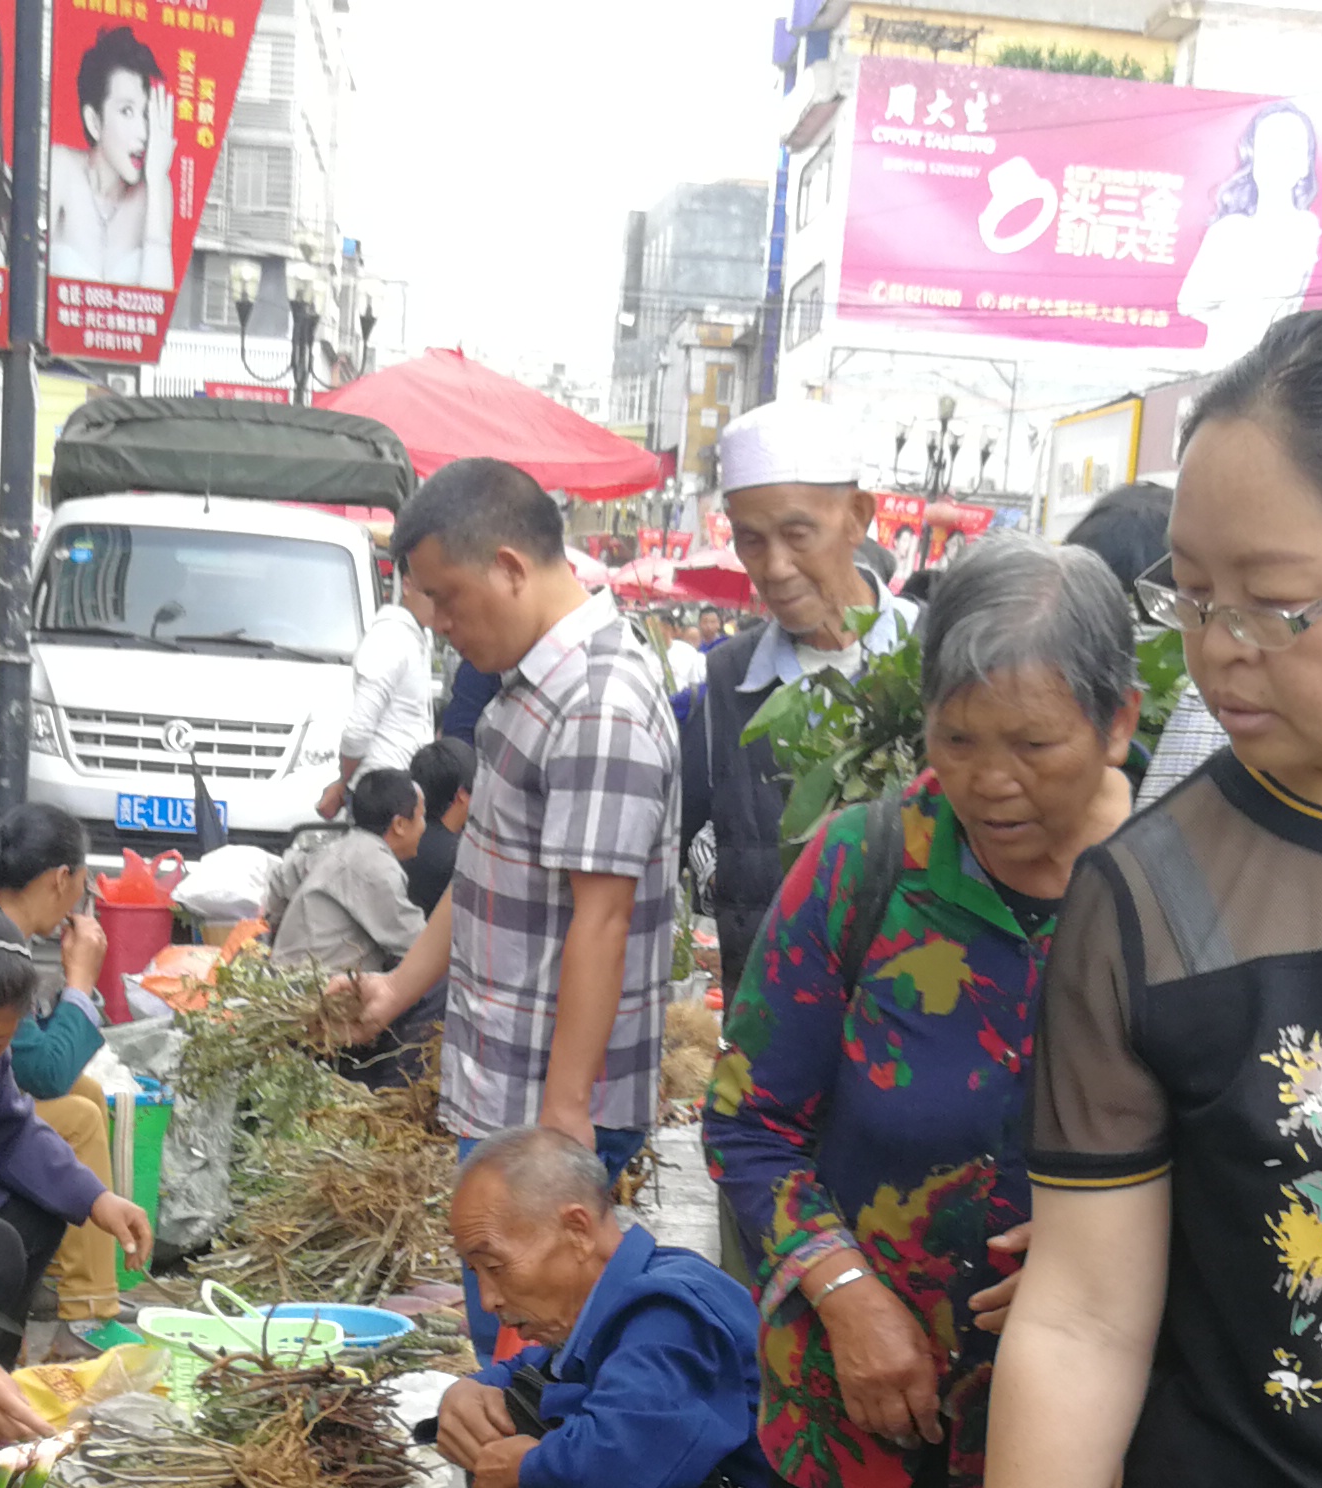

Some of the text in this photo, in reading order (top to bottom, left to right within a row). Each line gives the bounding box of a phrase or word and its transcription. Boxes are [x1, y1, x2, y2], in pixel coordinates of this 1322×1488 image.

[176, 48, 196, 122] 买三金
[884, 82, 990, 133] 周大生
[197, 77, 216, 149] 买放心
[1060, 178, 1183, 233] 买三金
[1055, 222, 1177, 265] 到周大生
